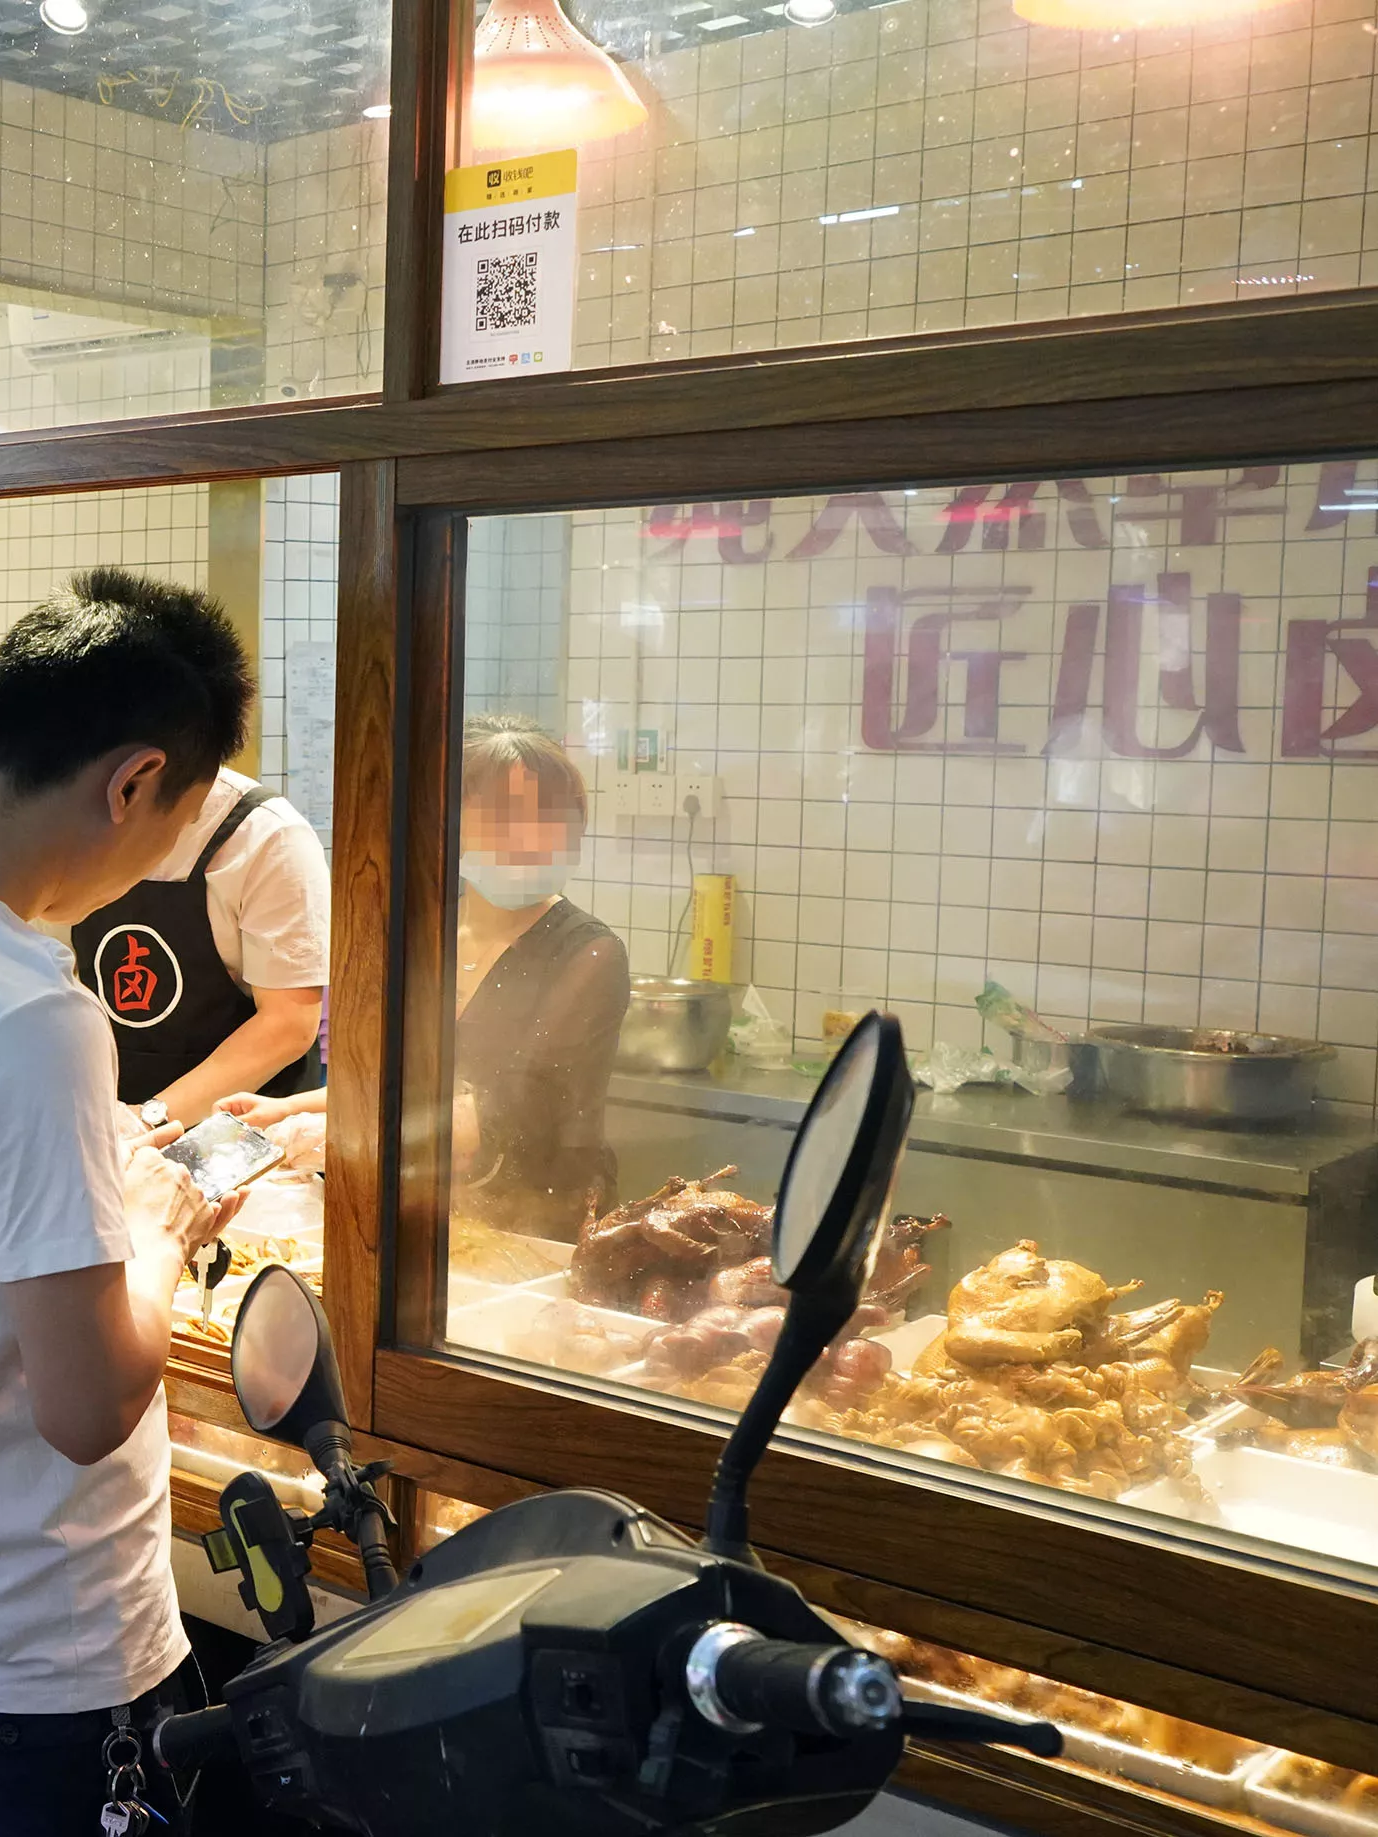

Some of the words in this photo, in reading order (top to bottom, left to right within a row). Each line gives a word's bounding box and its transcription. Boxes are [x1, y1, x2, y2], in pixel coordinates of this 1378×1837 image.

[458, 210, 560, 244] 在此扫码付款
[114, 934, 158, 1011] 卤
